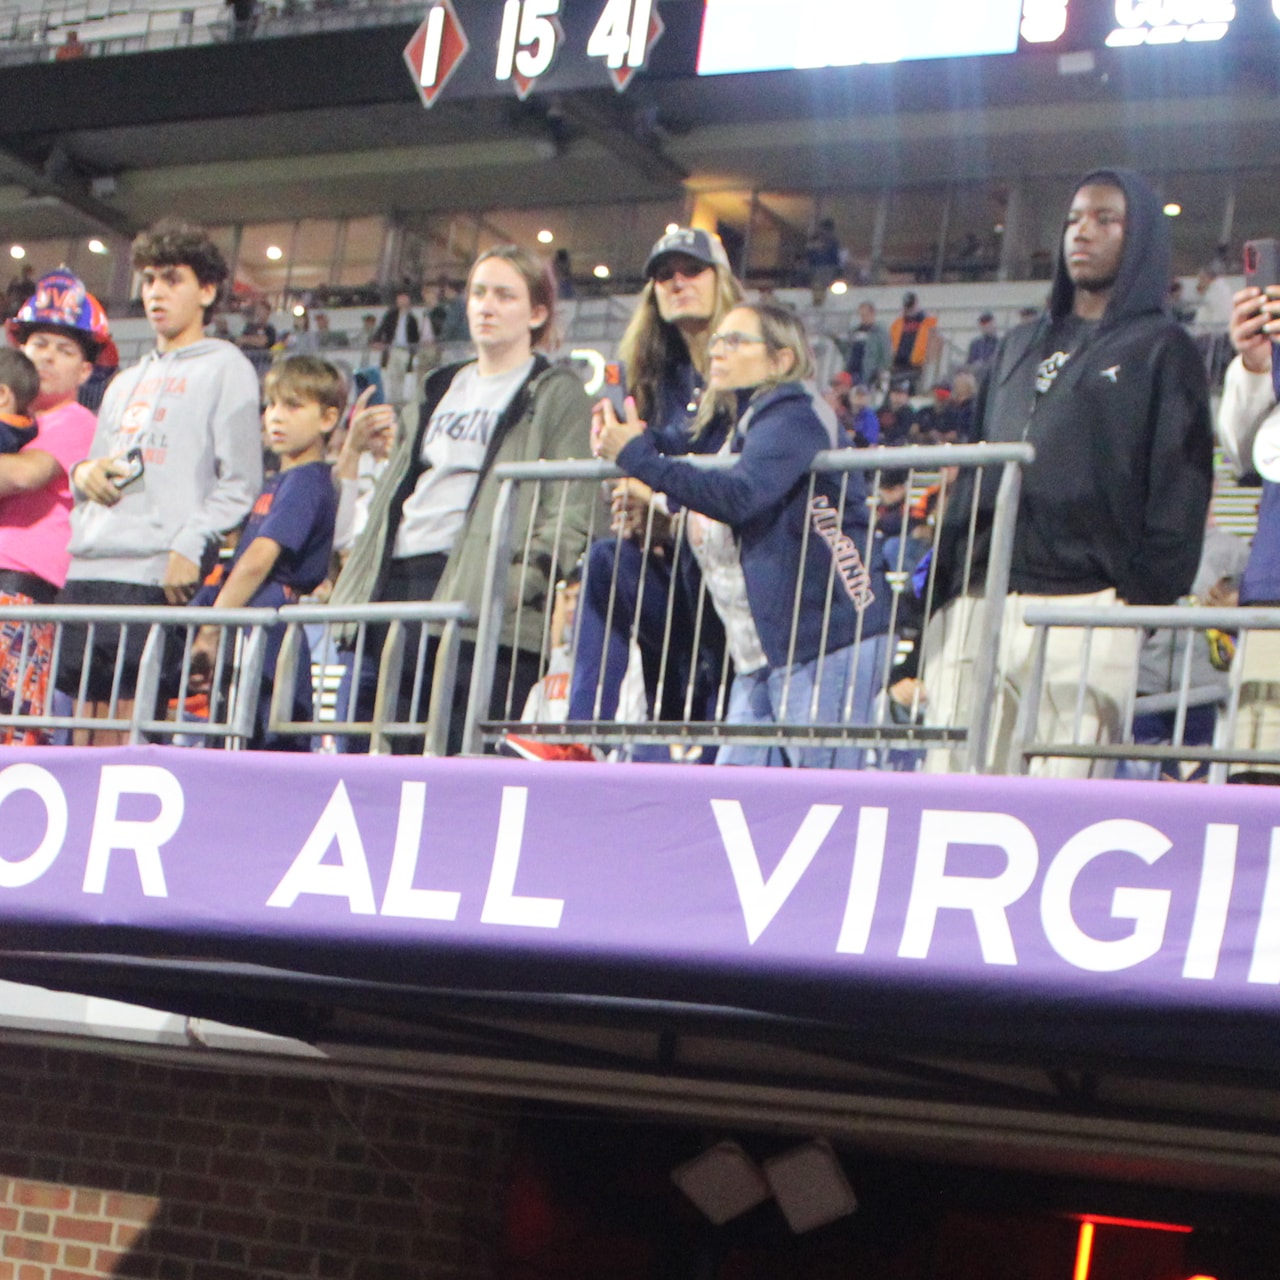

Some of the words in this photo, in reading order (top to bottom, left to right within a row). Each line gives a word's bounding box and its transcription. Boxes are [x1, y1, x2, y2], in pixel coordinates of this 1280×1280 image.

[495, 0, 558, 80] 15
[587, 0, 651, 68] 41
[267, 778, 565, 929] ALL
